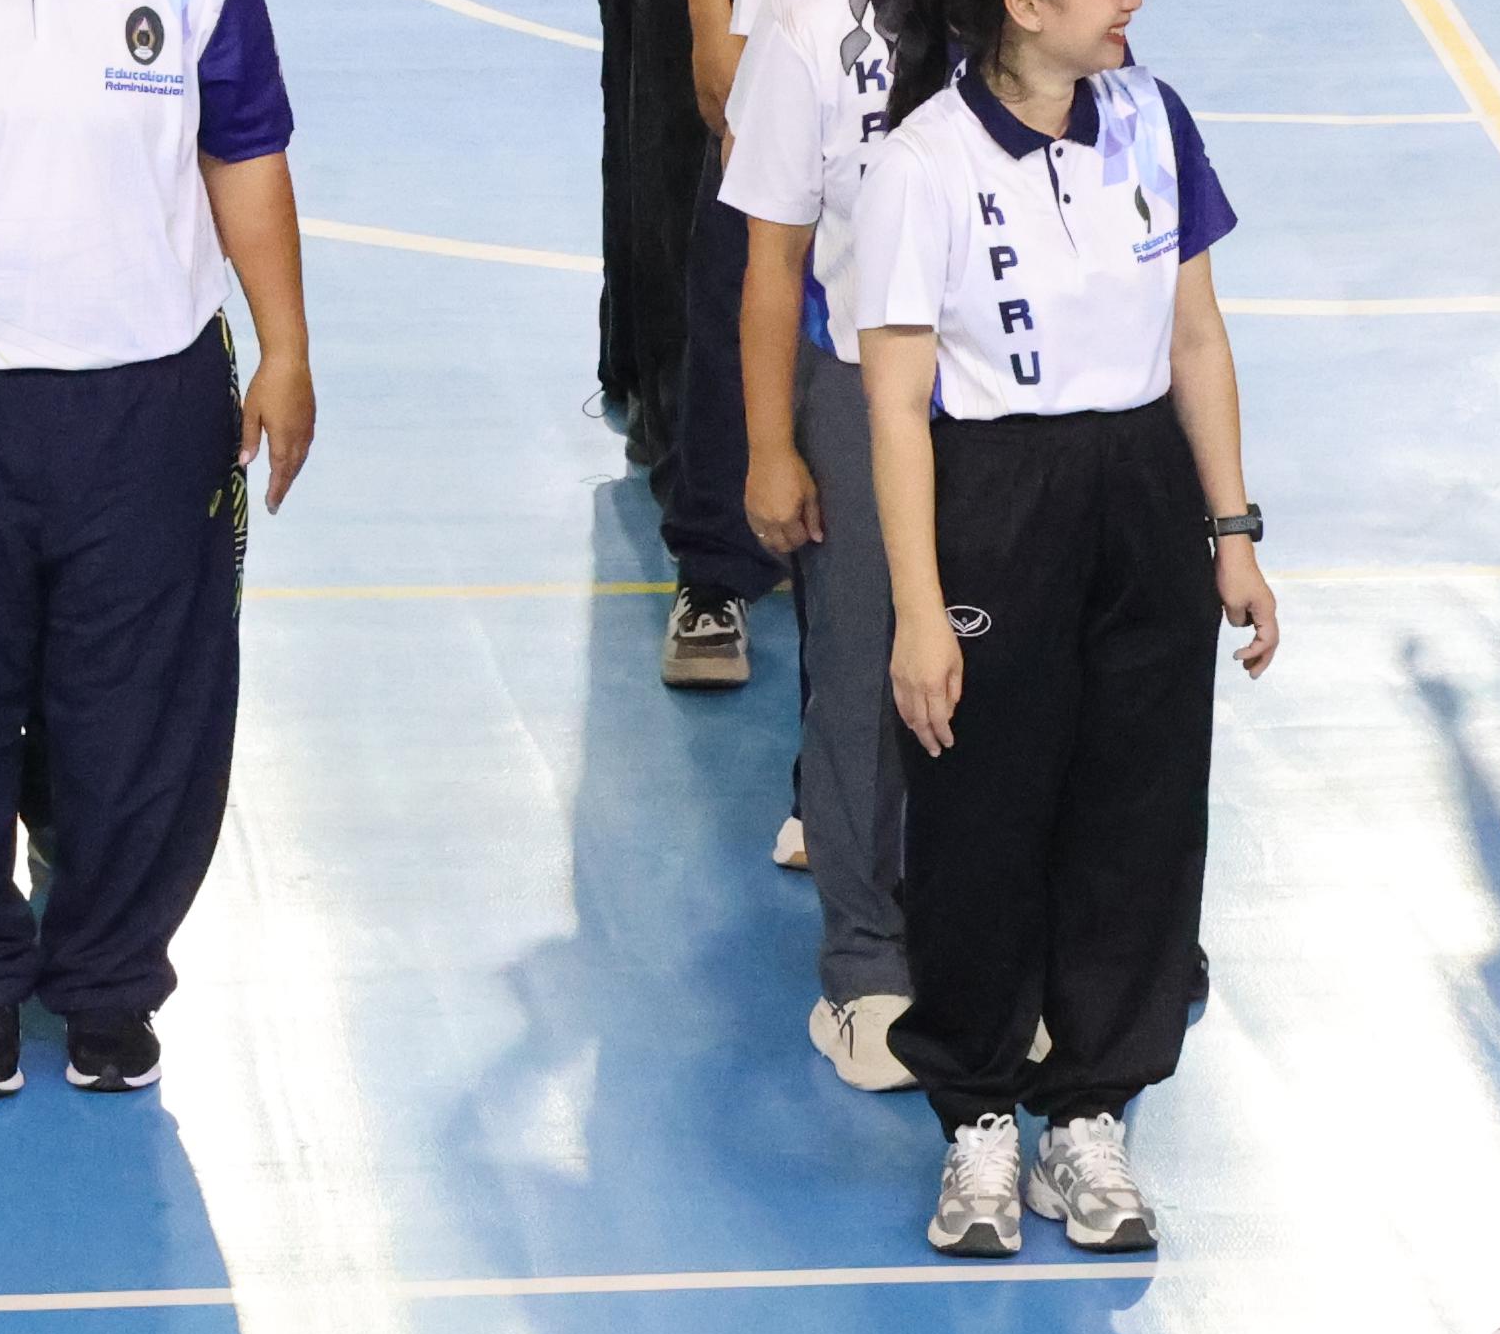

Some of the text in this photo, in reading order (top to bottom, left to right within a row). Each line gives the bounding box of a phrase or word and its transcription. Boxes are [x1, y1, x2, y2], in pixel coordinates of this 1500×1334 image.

[105, 68, 184, 84] Educationa
[856, 59, 890, 180] KP
[978, 192, 1041, 385] KPRU
